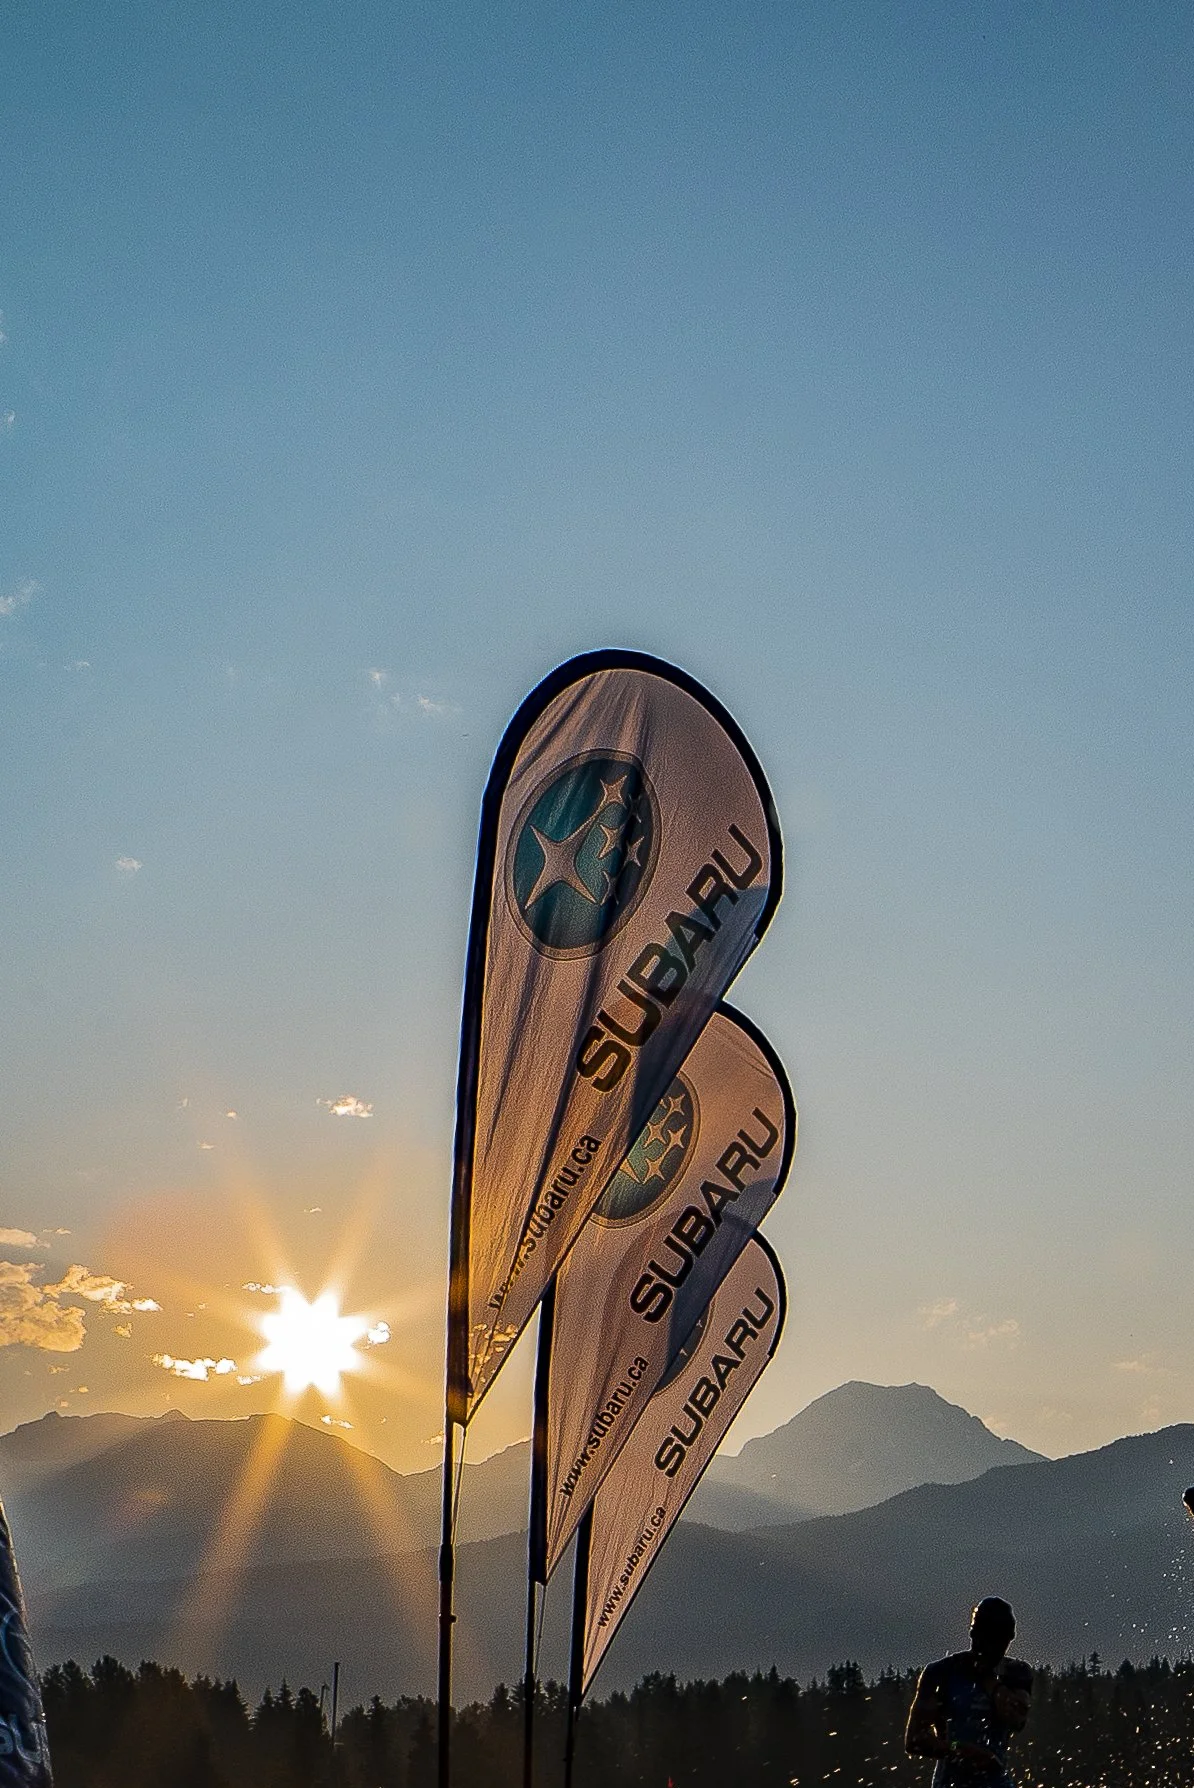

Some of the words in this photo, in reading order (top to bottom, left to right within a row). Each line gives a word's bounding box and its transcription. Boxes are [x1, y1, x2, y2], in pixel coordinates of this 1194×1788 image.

[577, 823, 763, 1093] SUBARU
[487, 1135, 602, 1309] w.subaru.ca
[630, 1107, 780, 1324] SUBARU
[561, 1356, 650, 1498] www.subaru.ca
[654, 1288, 775, 1479] SUBARU
[597, 1505, 667, 1628] www.subaru.ca
